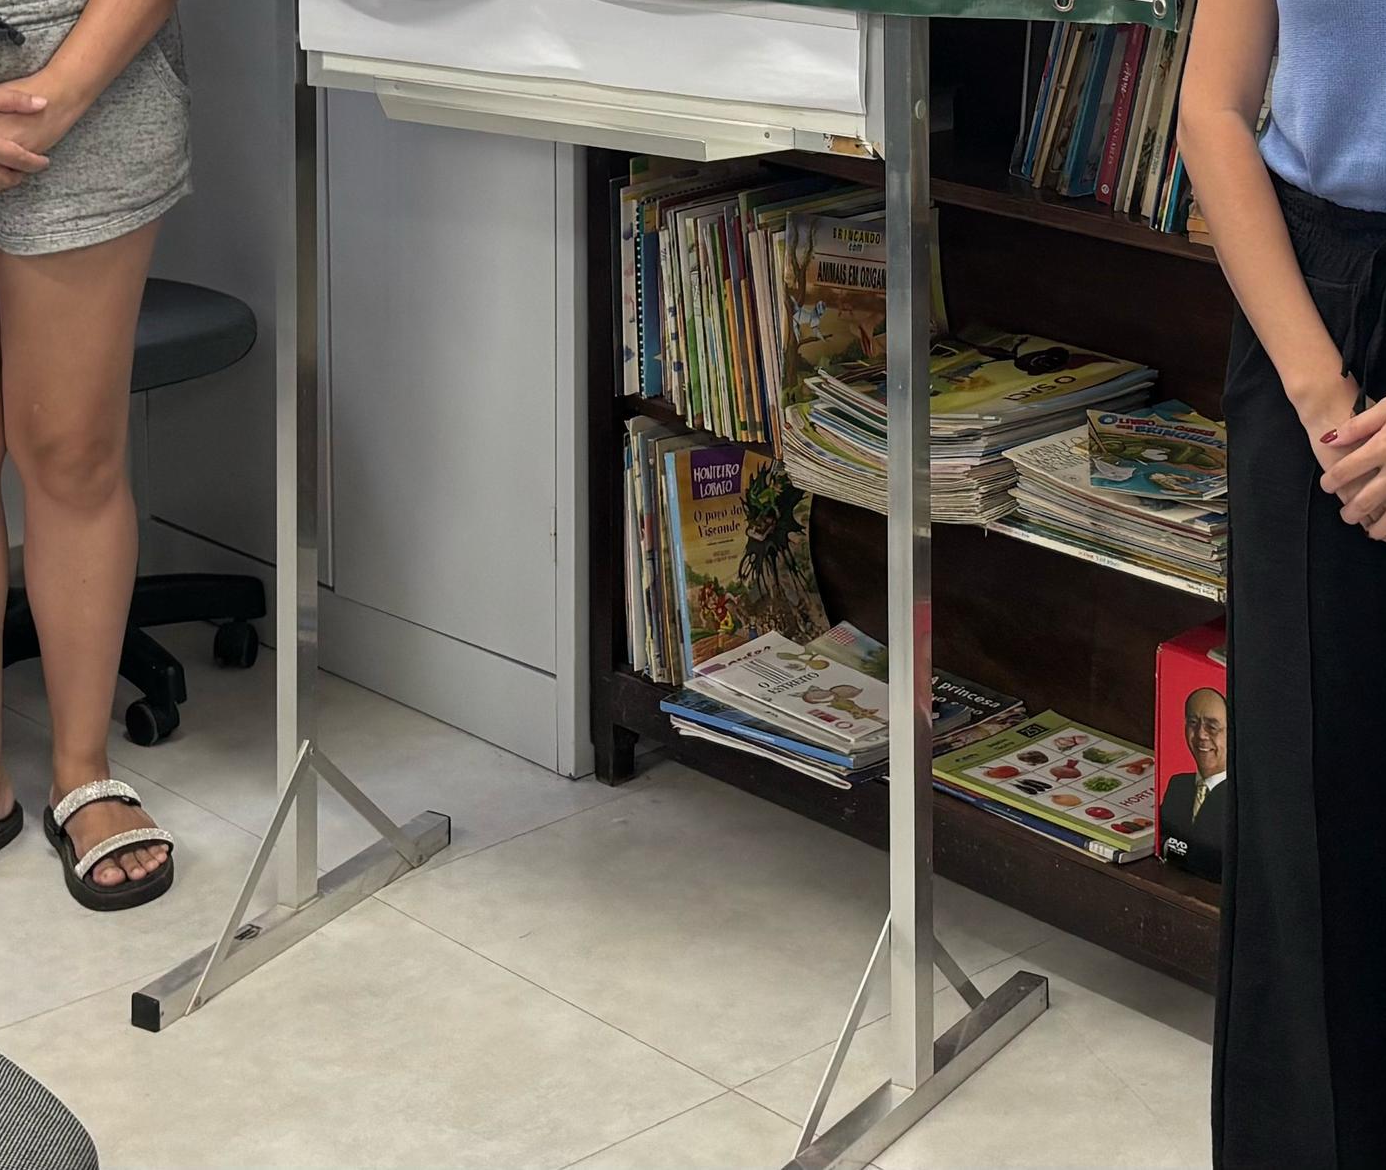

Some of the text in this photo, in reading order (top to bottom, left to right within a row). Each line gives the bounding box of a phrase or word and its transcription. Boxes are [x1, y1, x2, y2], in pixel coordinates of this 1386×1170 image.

[833, 228, 881, 244] BRINCANDO
[816, 261, 847, 284] ANIMAIS
[848, 264, 859, 286] EM
[693, 464, 740, 483] MONTEIRO
[699, 480, 733, 498] LOBATO
[694, 510, 702, 524] O
[698, 520, 741, 538] Visconde
[767, 671, 820, 695] ESTREITO
[937, 682, 1001, 708] princesa
